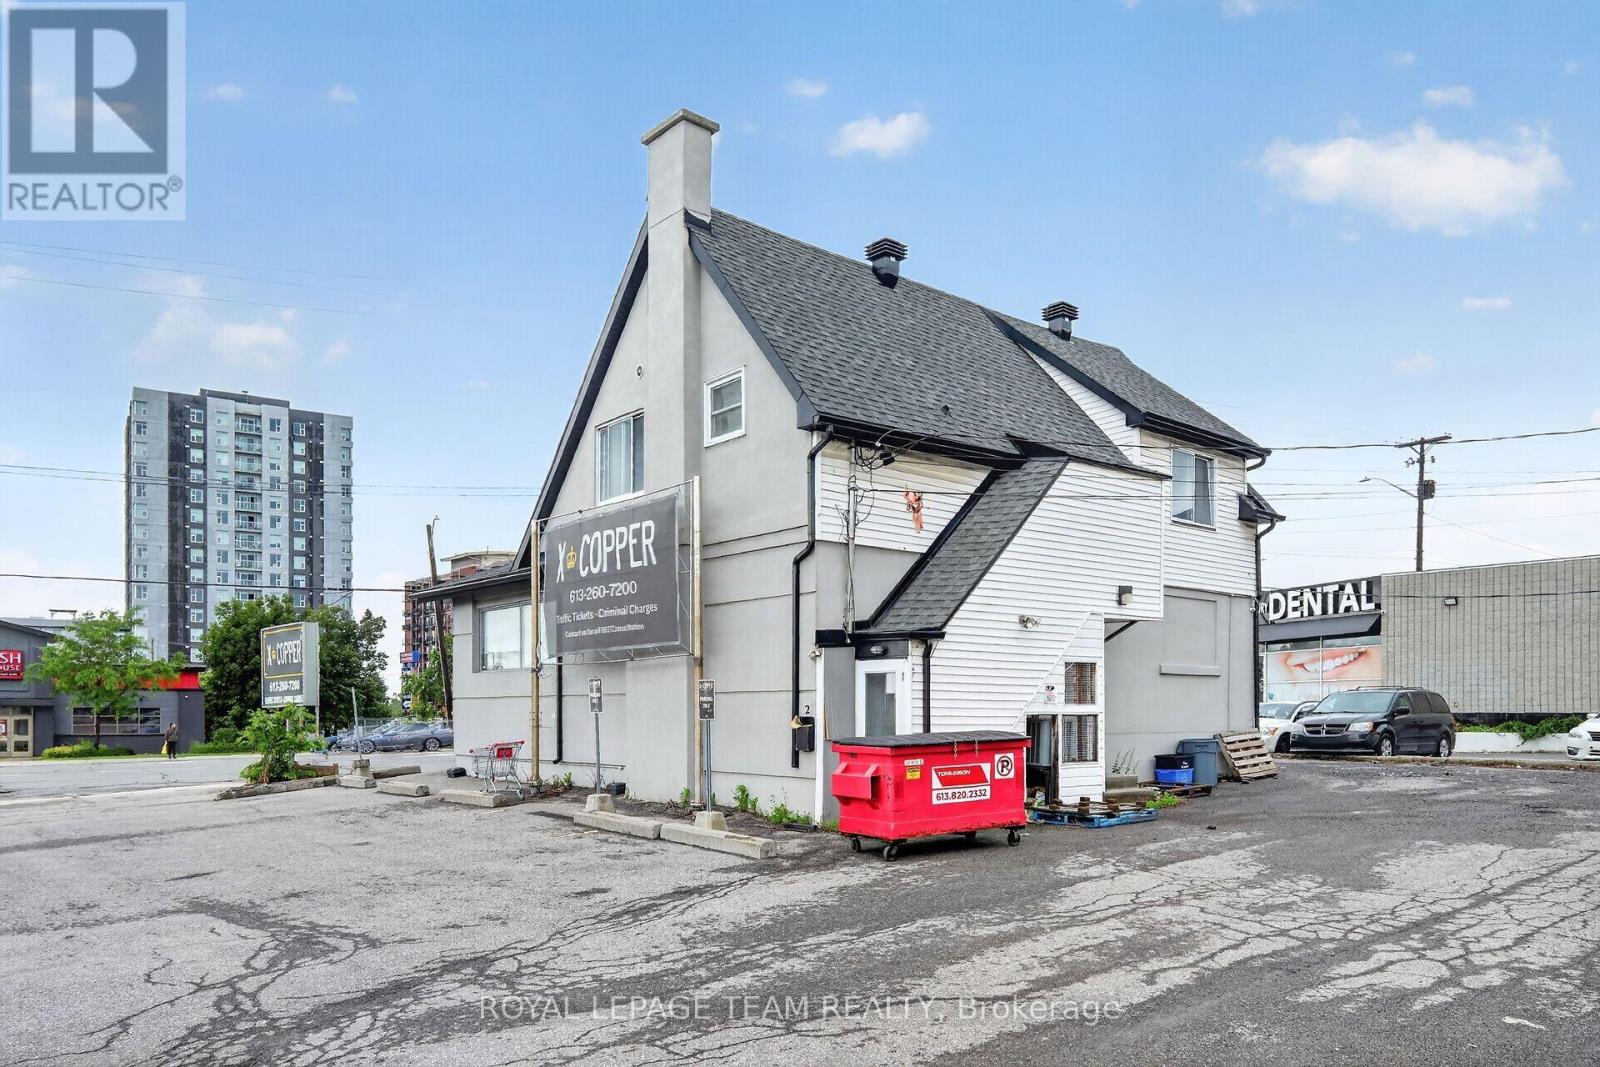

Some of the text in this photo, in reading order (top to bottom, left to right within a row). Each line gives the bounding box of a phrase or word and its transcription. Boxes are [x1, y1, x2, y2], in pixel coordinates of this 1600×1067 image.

[556, 520, 657, 583] X COPPER
[569, 580, 638, 604] 613-260-7200
[1268, 580, 1376, 621] DENTAL
[573, 610, 595, 622] Tickets
[629, 603, 659, 615] Charges
[266, 640, 302, 667] X COPPER
[804, 704, 811, 715] 2
[935, 788, 988, 801] 613.820.2332
